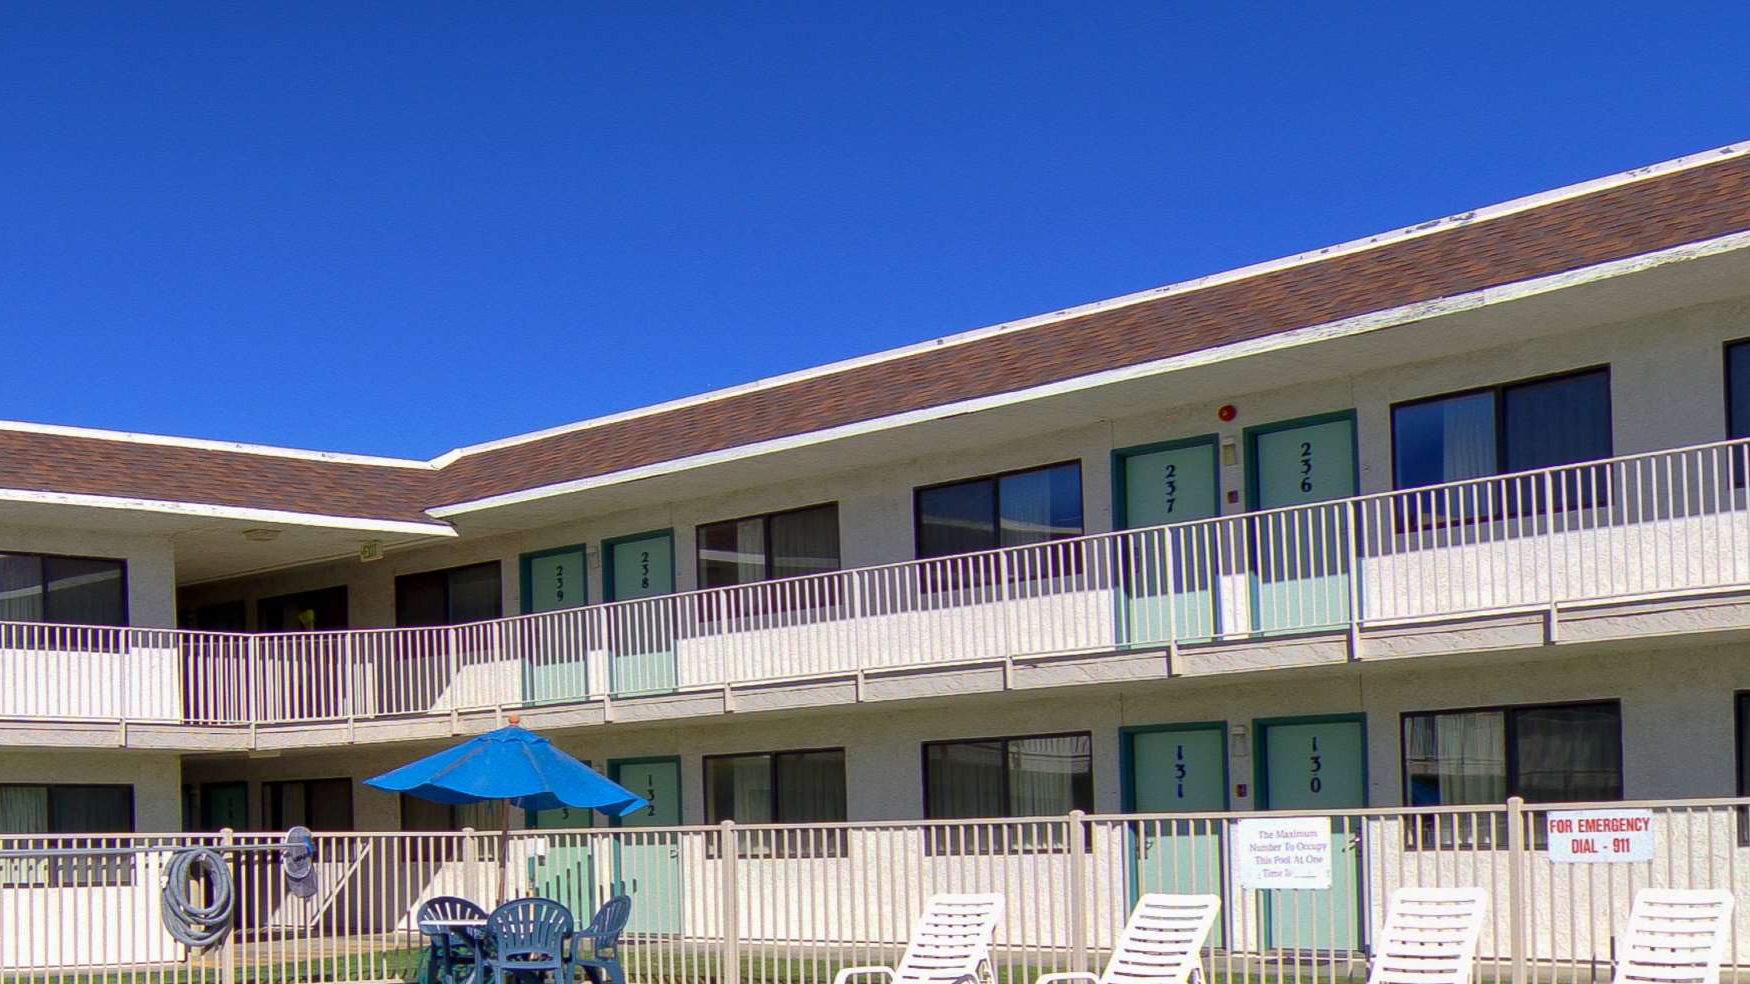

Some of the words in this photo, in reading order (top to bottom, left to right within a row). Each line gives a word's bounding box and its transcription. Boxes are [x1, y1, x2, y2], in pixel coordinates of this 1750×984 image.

[1300, 441, 1313, 493] 236
[1165, 464, 1177, 514] 237
[556, 565, 564, 602] 239
[641, 551, 650, 589] 238
[1174, 744, 1187, 799] 131
[1309, 735, 1322, 794] 130
[1259, 830, 1274, 839] The
[1276, 830, 1318, 839] Maximum
[1550, 819, 1573, 833] FOR
[1577, 817, 1651, 833] EMERGENCY
[1255, 856, 1272, 865] This
[1274, 856, 1291, 865] Pool
[1306, 855, 1324, 864] One
[1285, 842, 1295, 851] To
[1571, 839, 1598, 854] DIAL
[1612, 838, 1631, 853] 911
